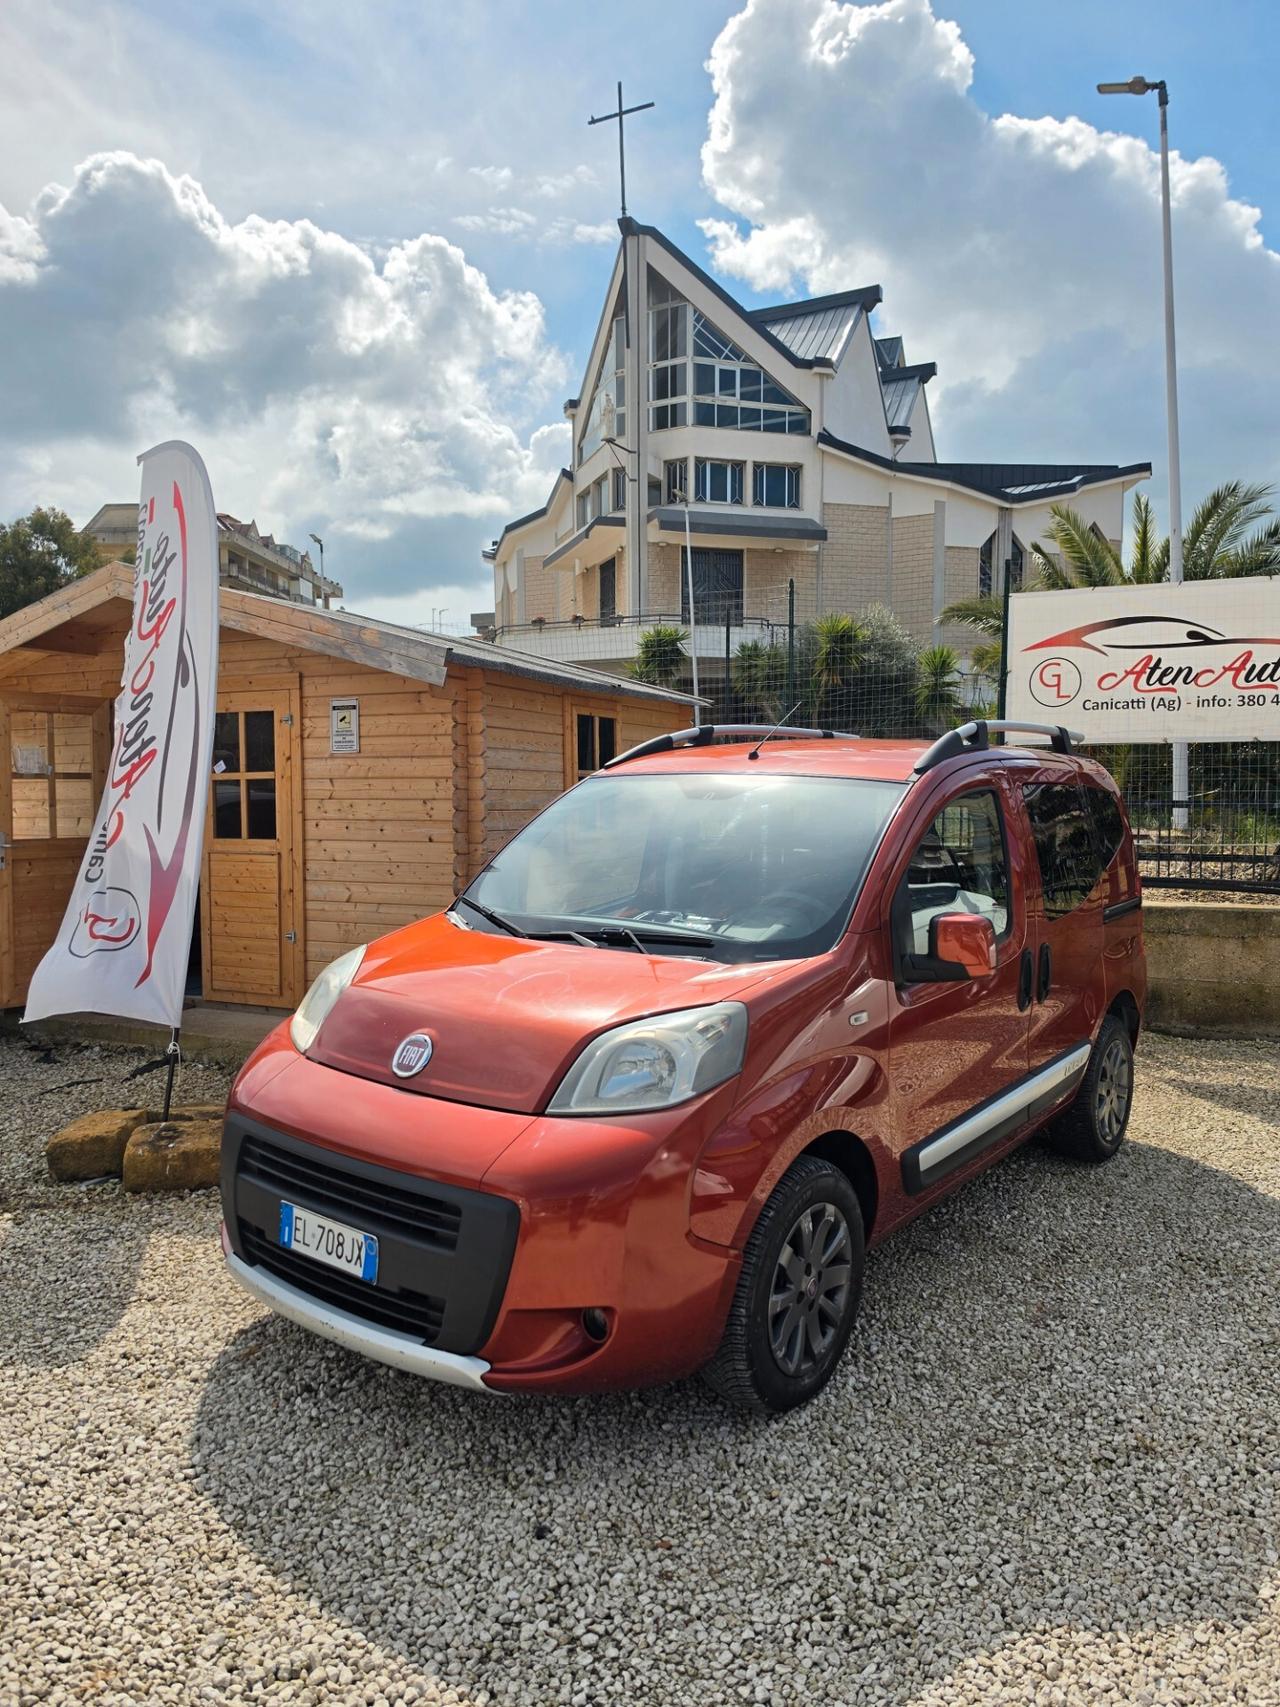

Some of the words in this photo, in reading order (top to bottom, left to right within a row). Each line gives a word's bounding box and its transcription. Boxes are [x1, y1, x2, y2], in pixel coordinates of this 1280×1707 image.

[1082, 697, 1146, 711] Canicattì
[1151, 696, 1182, 712] (Ag)
[1196, 695, 1231, 708] info:
[1236, 694, 1266, 707] 380
[398, 1045, 425, 1066] FIAT
